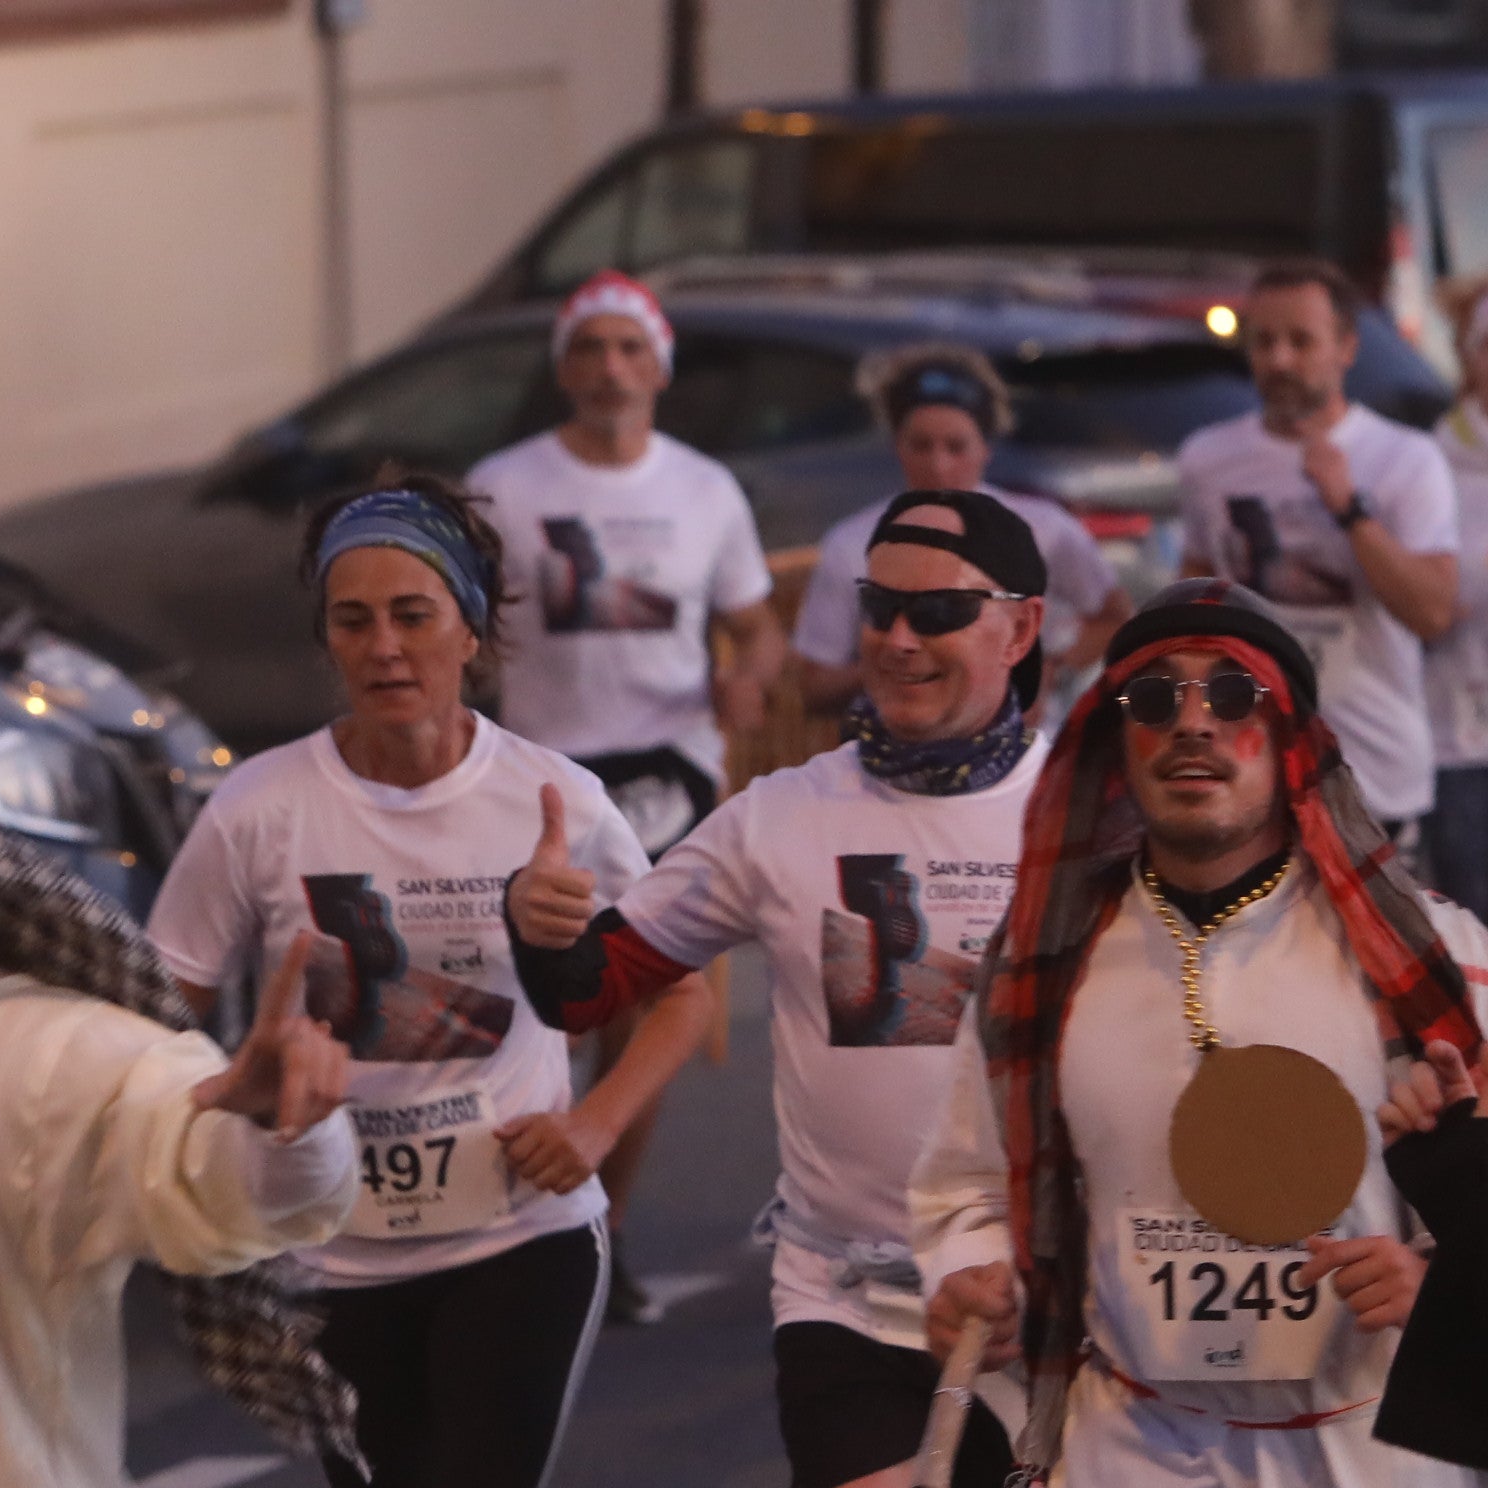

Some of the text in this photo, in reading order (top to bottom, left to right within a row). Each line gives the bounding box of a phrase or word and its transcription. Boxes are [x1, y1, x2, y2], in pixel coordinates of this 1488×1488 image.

[927, 860, 1018, 878] SAN SILVES
[397, 878, 431, 895] SAN
[362, 1136, 457, 1194] 497
[1132, 1218, 1185, 1232] SAN
[1133, 1233, 1220, 1251] CIUDAD
[1149, 1261, 1317, 1321] 1249
